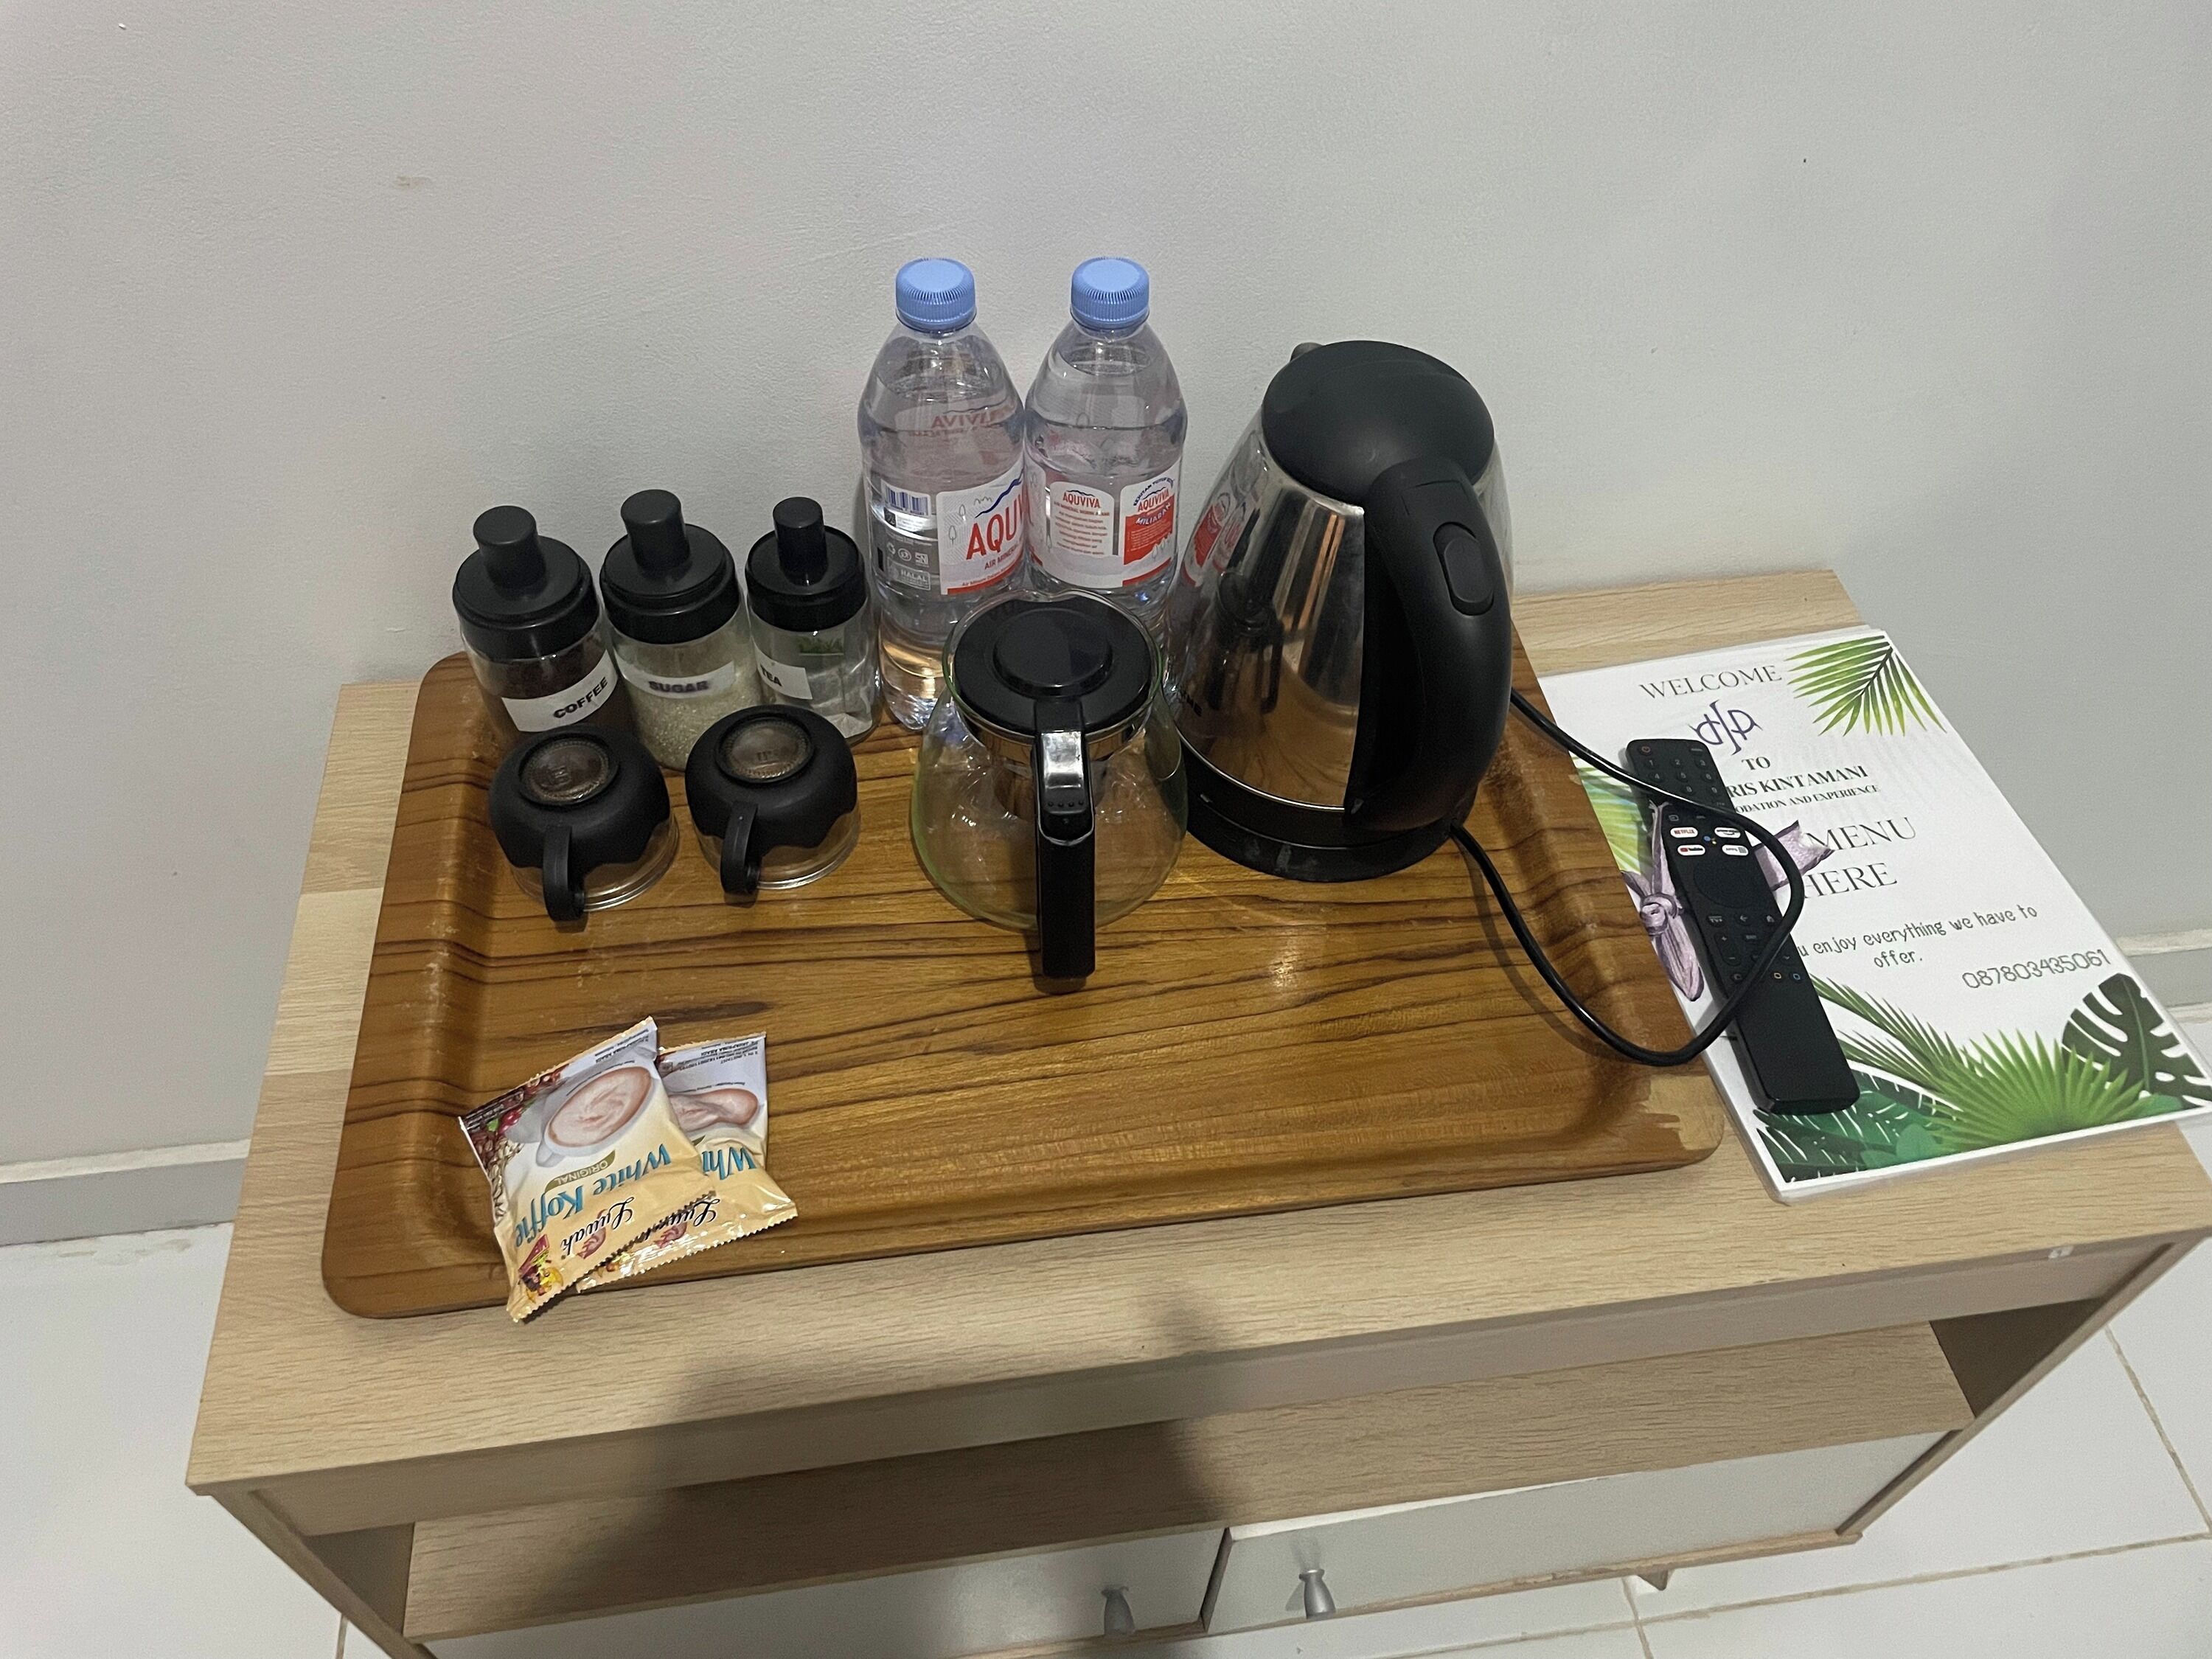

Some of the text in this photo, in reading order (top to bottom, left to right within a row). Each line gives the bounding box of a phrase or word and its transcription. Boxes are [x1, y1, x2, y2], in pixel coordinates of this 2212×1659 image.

[1062, 492, 1101, 509] AQUVIVA
[1138, 488, 1170, 512] AQUVIVA
[900, 569, 928, 582] HALAL
[648, 681, 710, 694] SUGAR
[761, 665, 783, 687] TEA
[1639, 665, 1783, 699] WELCOME
[552, 676, 608, 718] COFFEE
[1742, 756, 1771, 771] TO
[1759, 765, 1868, 793] KINTAMANI
[1789, 796, 1812, 806] AND
[1813, 785, 1881, 801] EXPERIENCE
[1806, 816, 1917, 851] MENU
[1798, 904, 2038, 957] u enjoy everything we have to
[1874, 950, 1923, 968] offer.
[1962, 948, 2112, 989] 087803435061
[553, 1160, 608, 1185] ORIGINAL
[515, 1144, 672, 1248] White Koffie
[560, 1197, 635, 1256] Luwak
